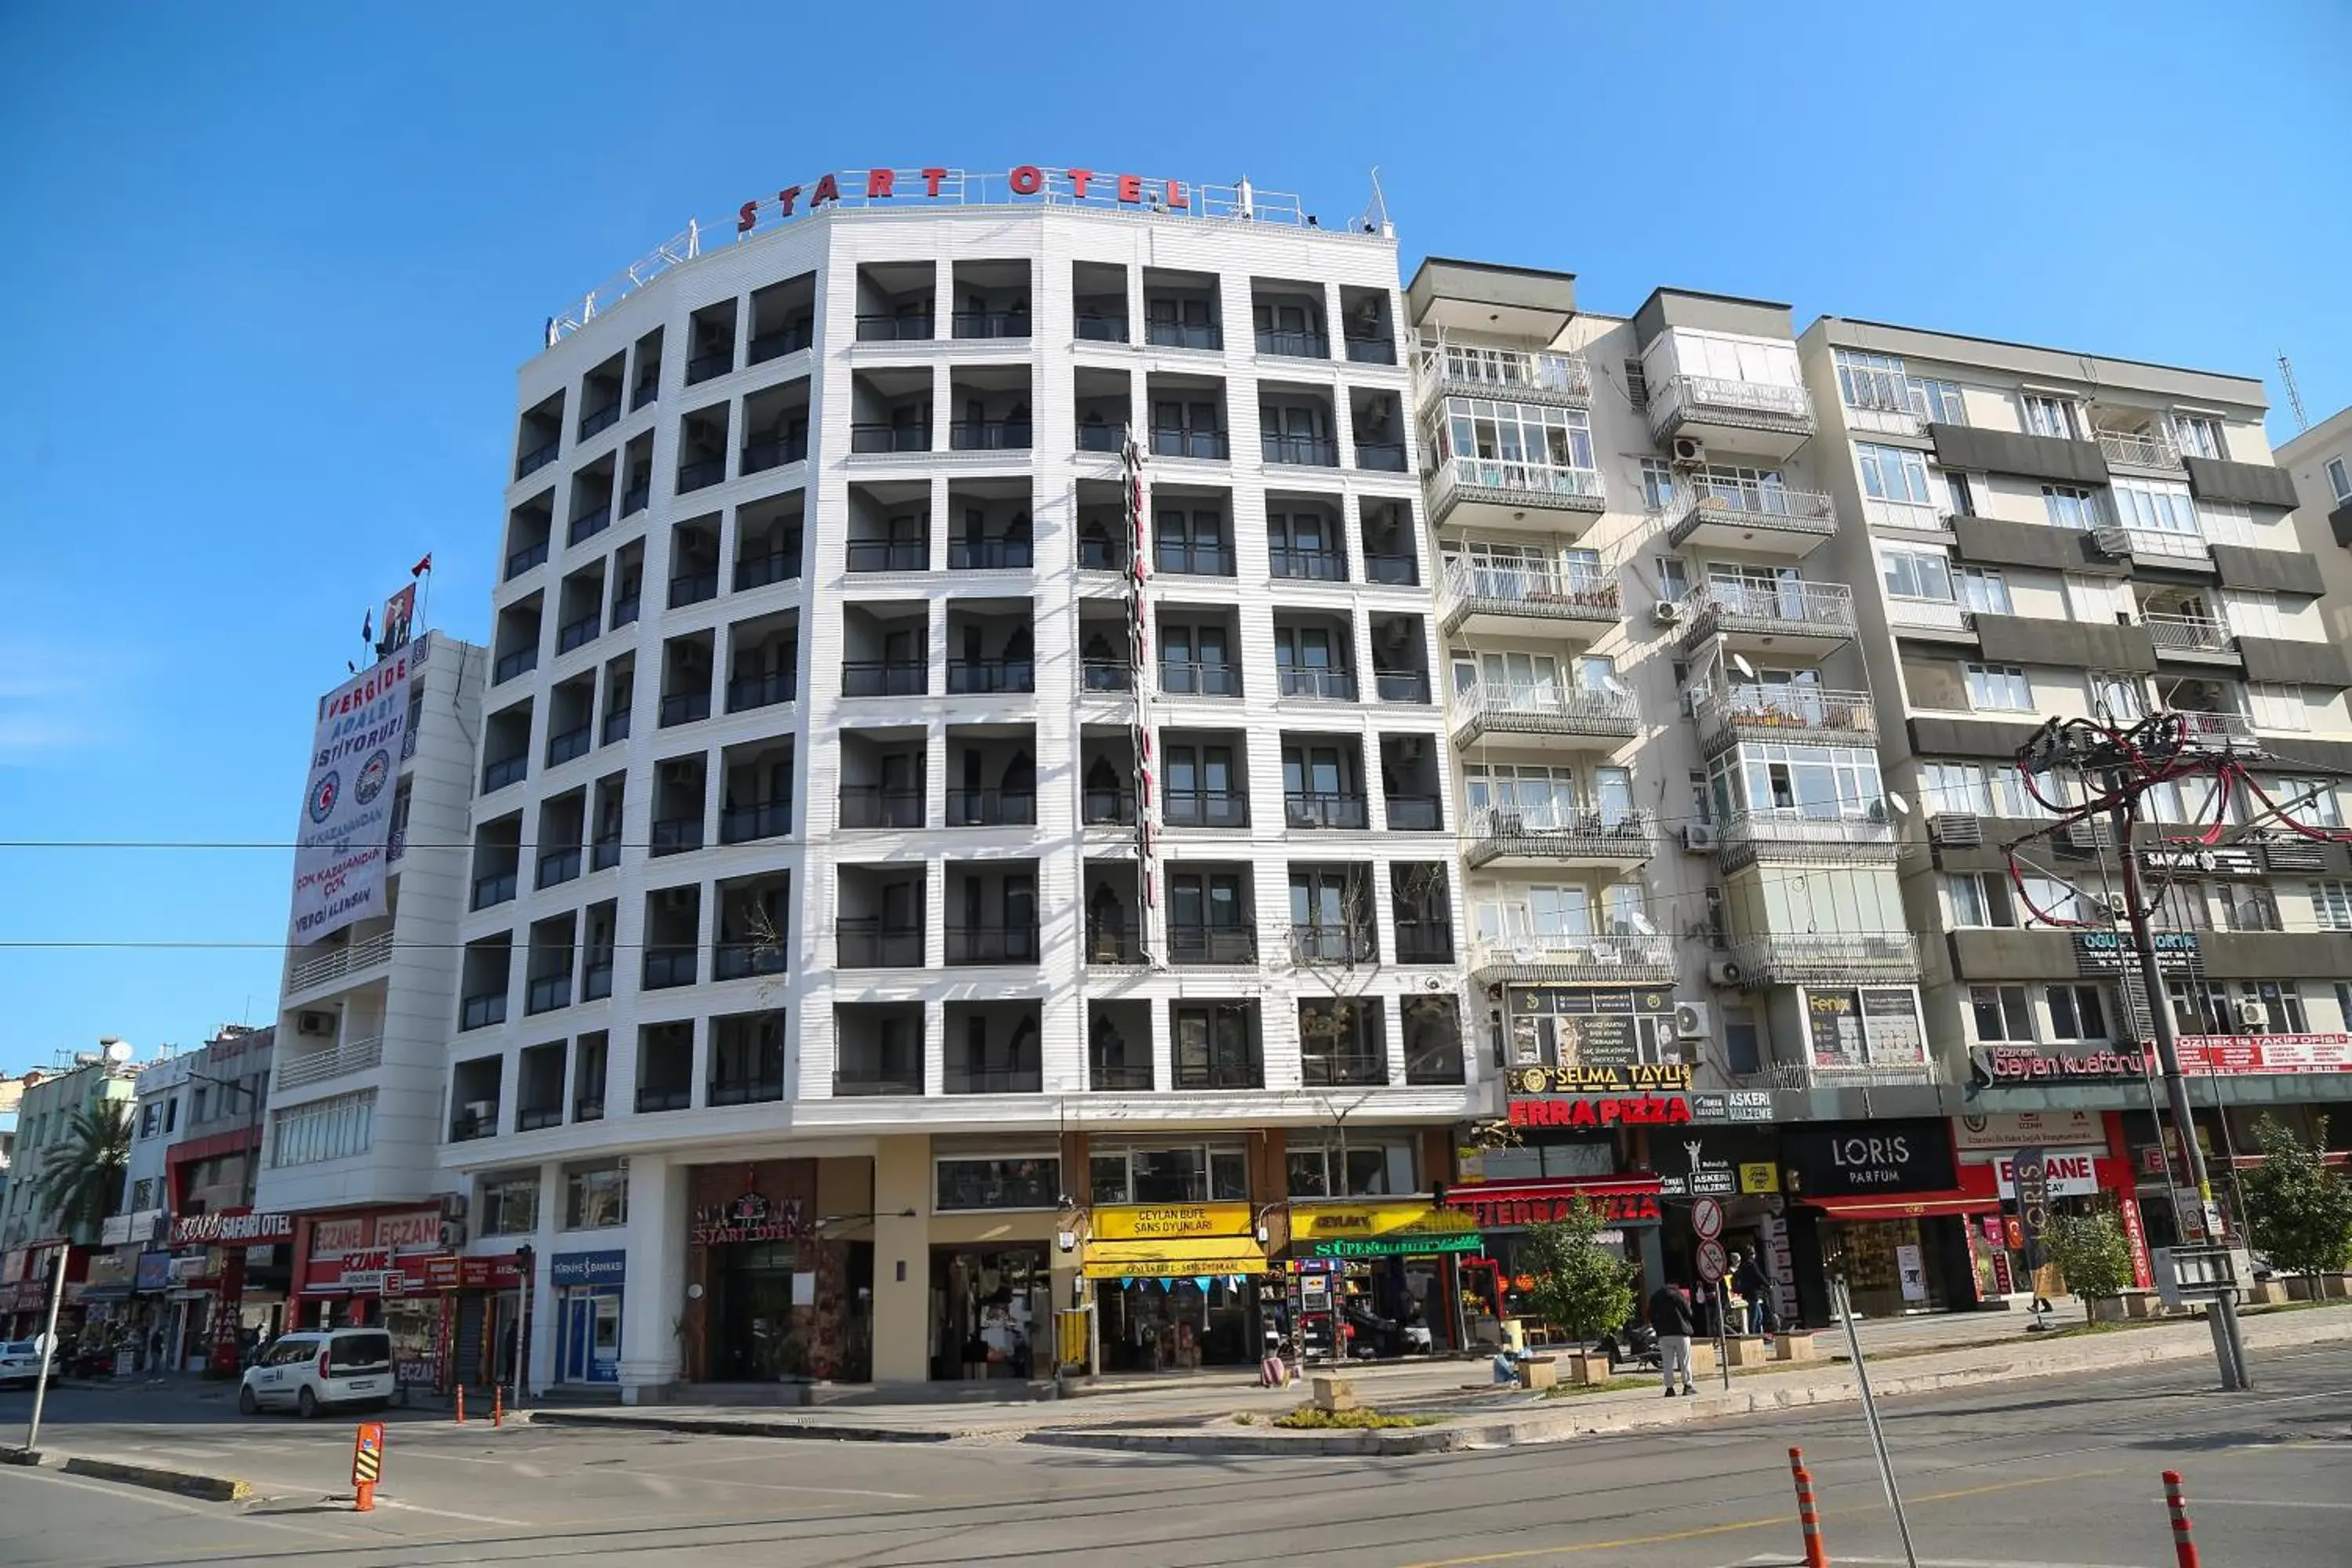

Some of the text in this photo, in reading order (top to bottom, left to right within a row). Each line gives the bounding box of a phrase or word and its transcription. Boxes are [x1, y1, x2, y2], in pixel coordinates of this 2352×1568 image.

[737, 165, 1189, 233] START OTEL
[328, 658, 406, 719] VERGİDE
[331, 692, 396, 742] ADALET
[1556, 1067, 1619, 1084] SELMA
[1627, 1065, 1682, 1082] TAYLI
[1832, 1136, 1910, 1166] LORIS
[2000, 1156, 2091, 1182] EANE
[261, 1214, 292, 1236] OTEL
[1138, 1208, 1178, 1221] CEYLAN
[314, 1222, 361, 1251] ECZANE
[341, 1250, 390, 1271] ECZANE
